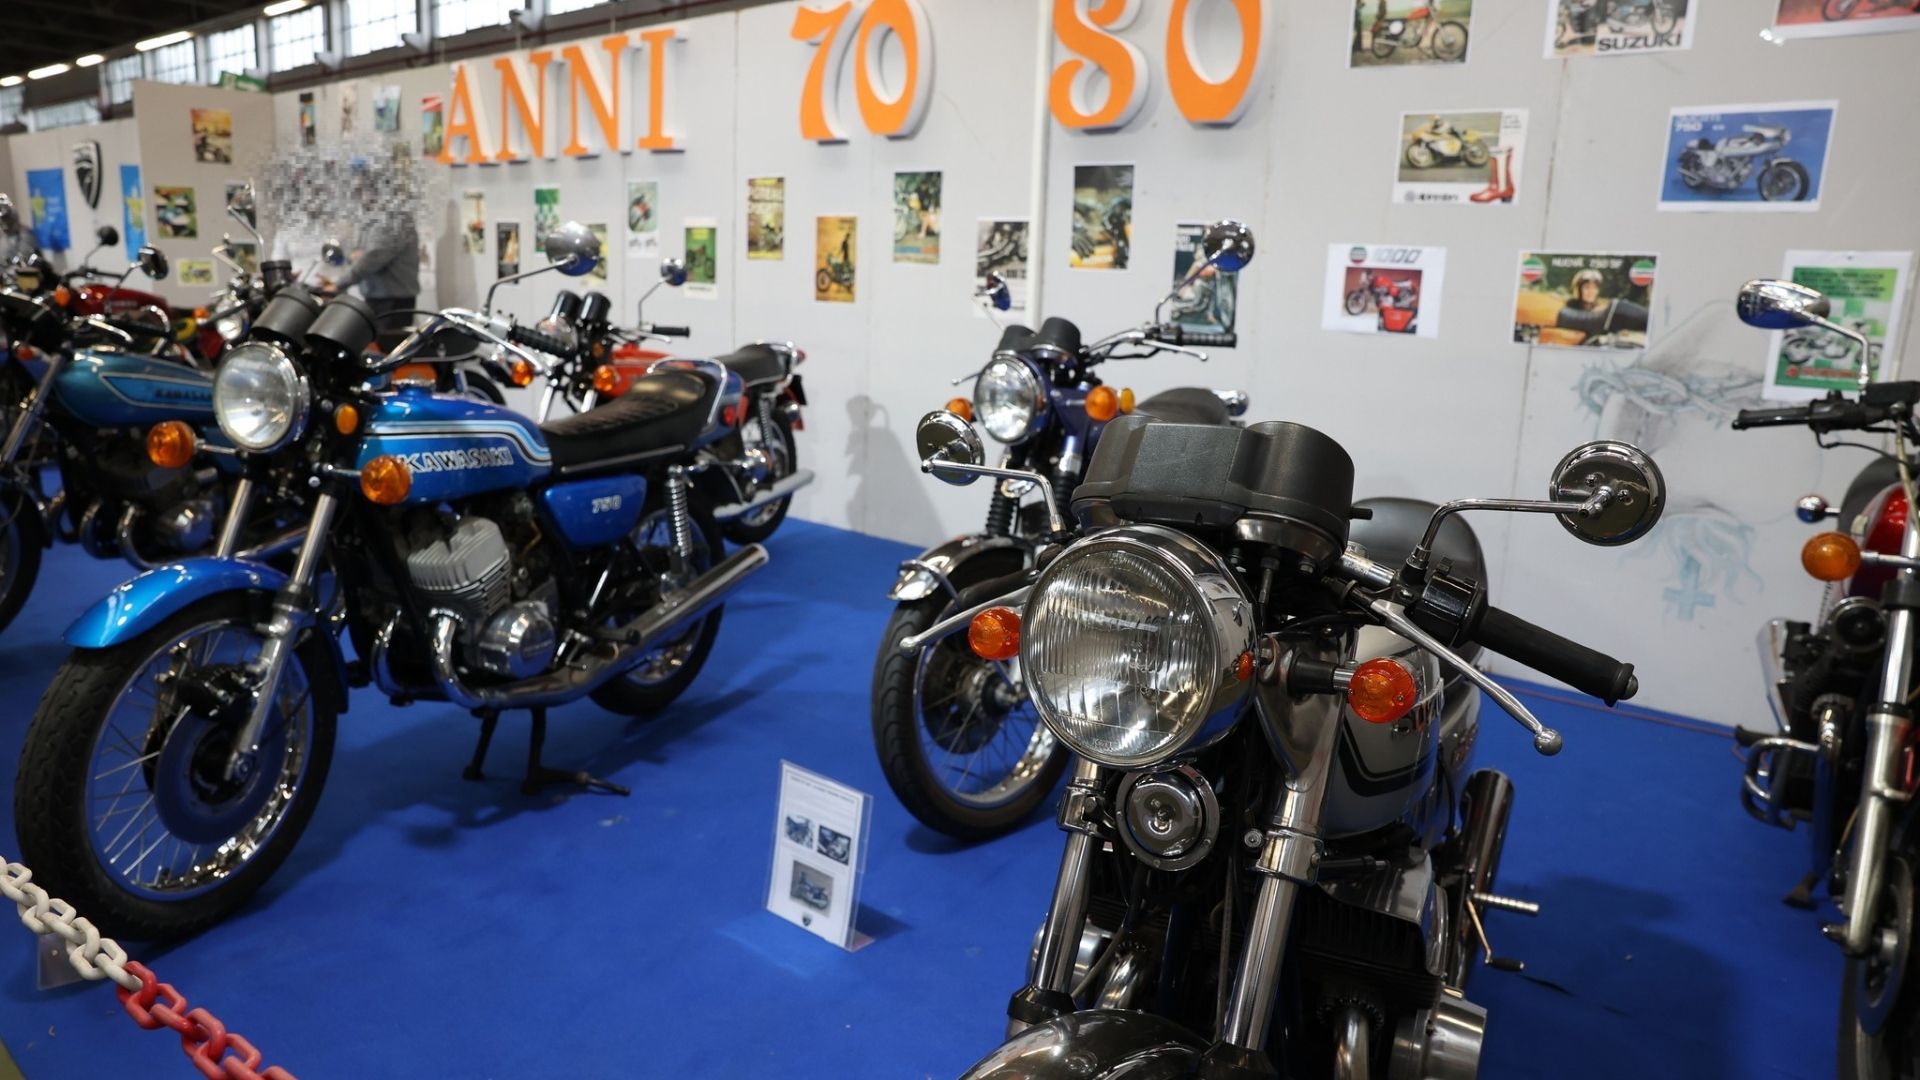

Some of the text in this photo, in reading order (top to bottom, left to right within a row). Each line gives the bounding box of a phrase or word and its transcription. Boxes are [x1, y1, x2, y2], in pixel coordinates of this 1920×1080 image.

[1598, 33, 1681, 51] SUZUKI
[436, 0, 1264, 164] ANNI 70 80
[401, 446, 514, 474] KAWASAKI
[591, 495, 622, 514] 750
